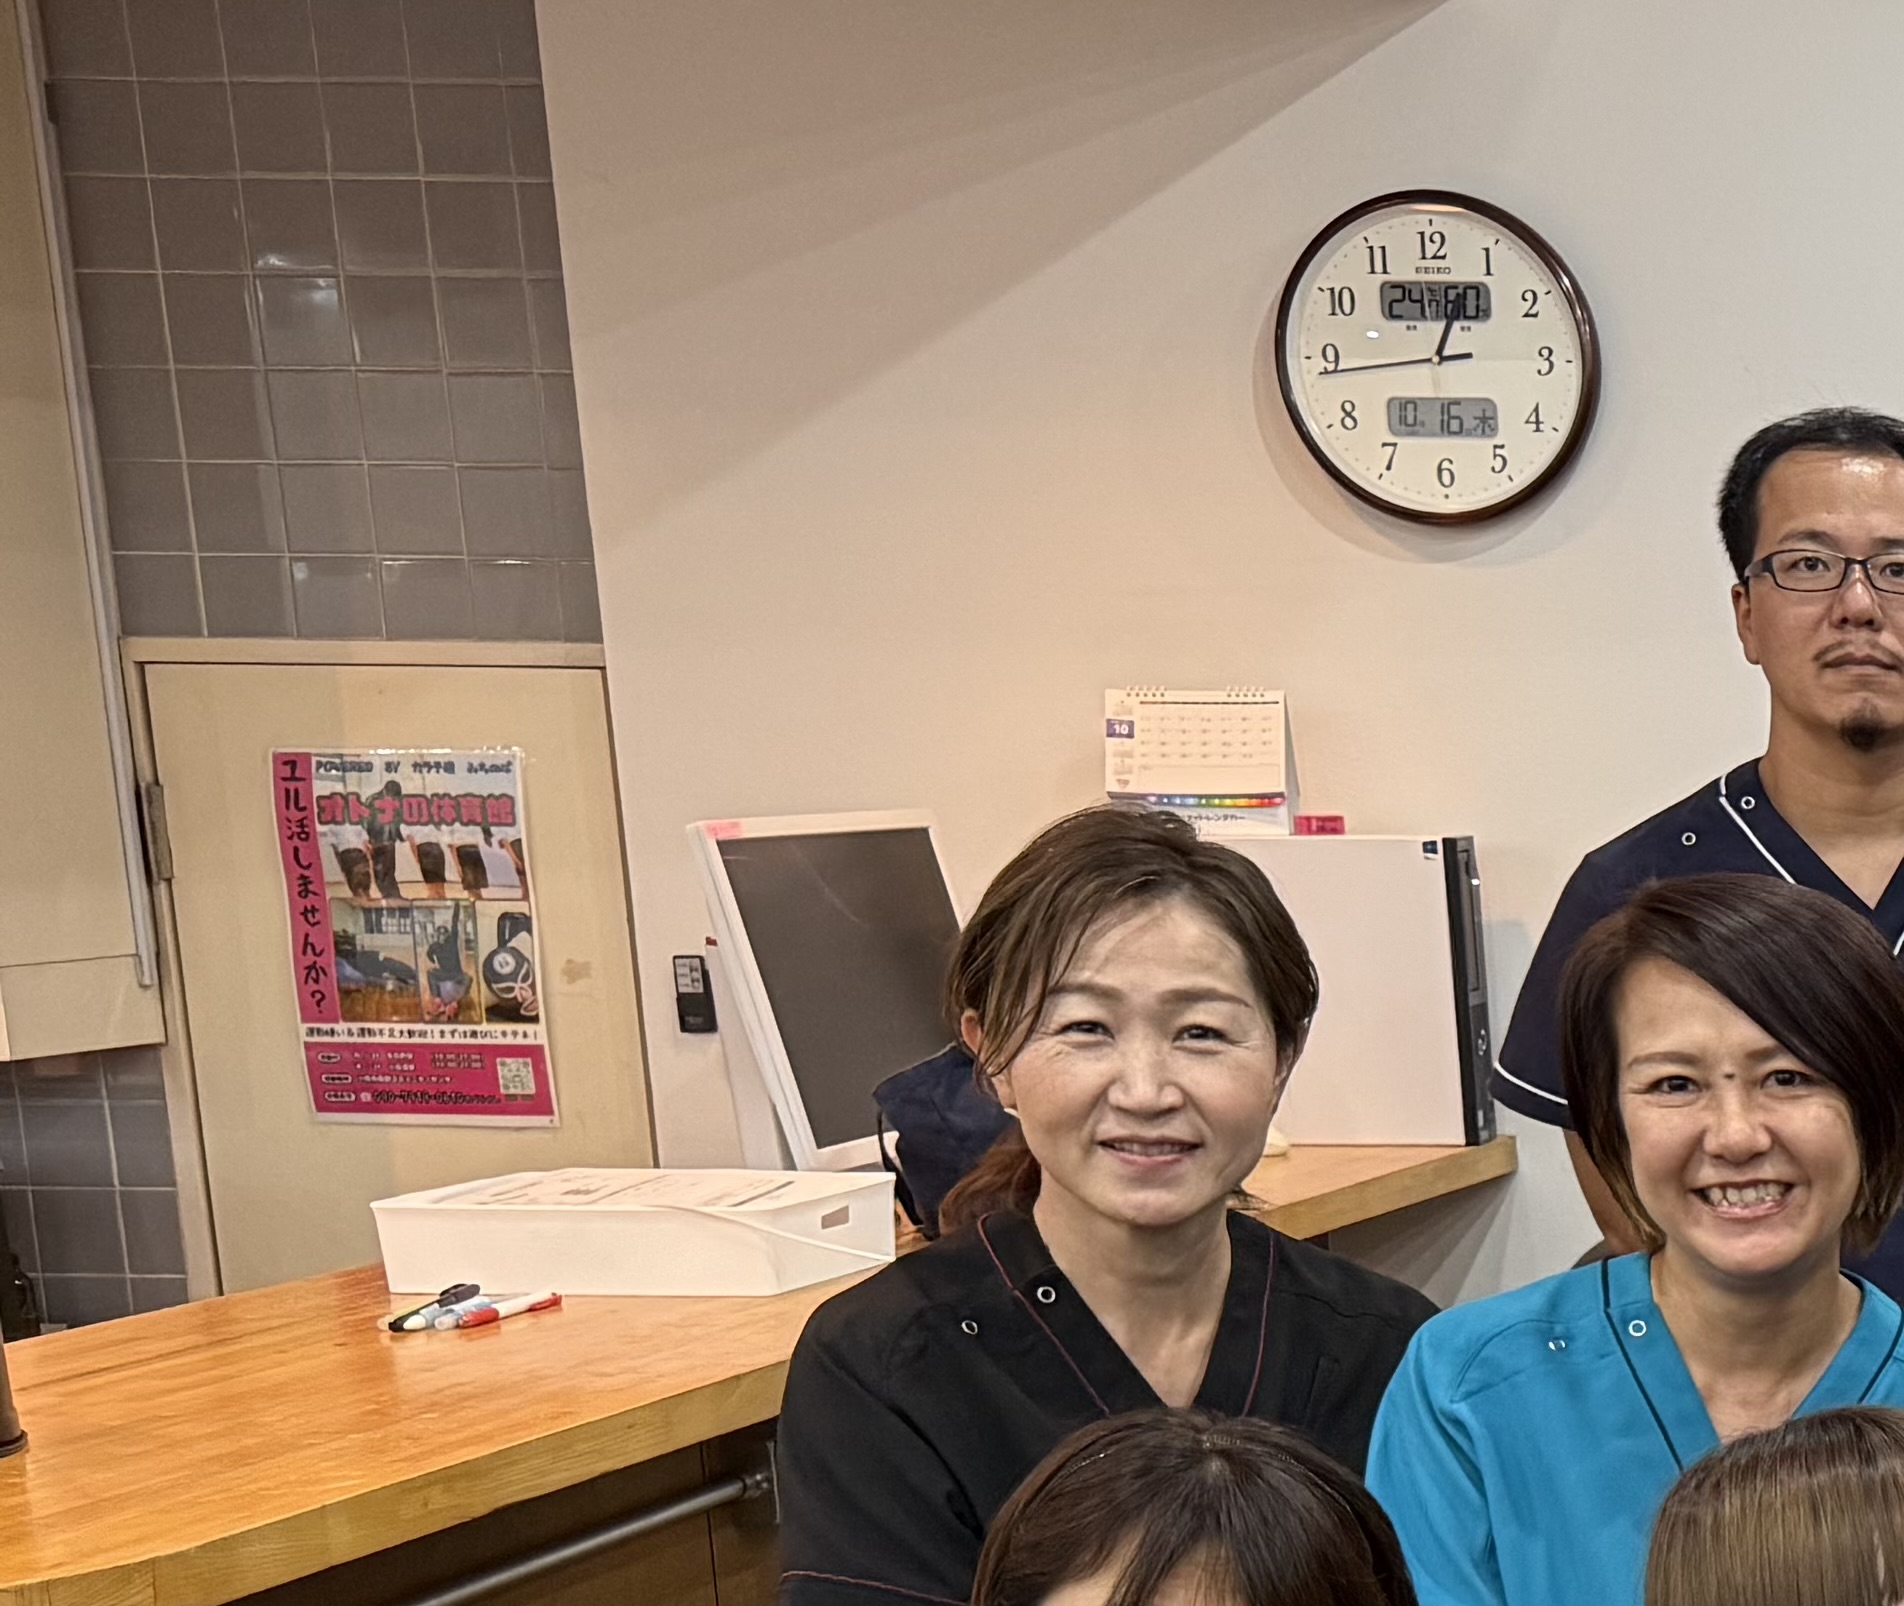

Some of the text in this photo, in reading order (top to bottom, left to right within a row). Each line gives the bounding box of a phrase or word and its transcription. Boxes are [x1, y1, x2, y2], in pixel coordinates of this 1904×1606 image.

[1366, 245, 1391, 275] 11
[1416, 231, 1447, 260] 12
[1415, 266, 1451, 274] SEIKO
[1481, 247, 1494, 277] 1
[1325, 286, 1356, 316] 10
[1521, 289, 1540, 318] 2
[1321, 343, 1340, 374] 9
[1537, 346, 1555, 376] 3
[1340, 400, 1358, 431] 8
[1525, 402, 1544, 432] 4
[1381, 442, 1398, 471] 7
[1491, 444, 1508, 474] 5
[1437, 457, 1455, 488] 6
[1113, 725, 1129, 735] 10
[316, 792, 516, 827] オトナの体育館
